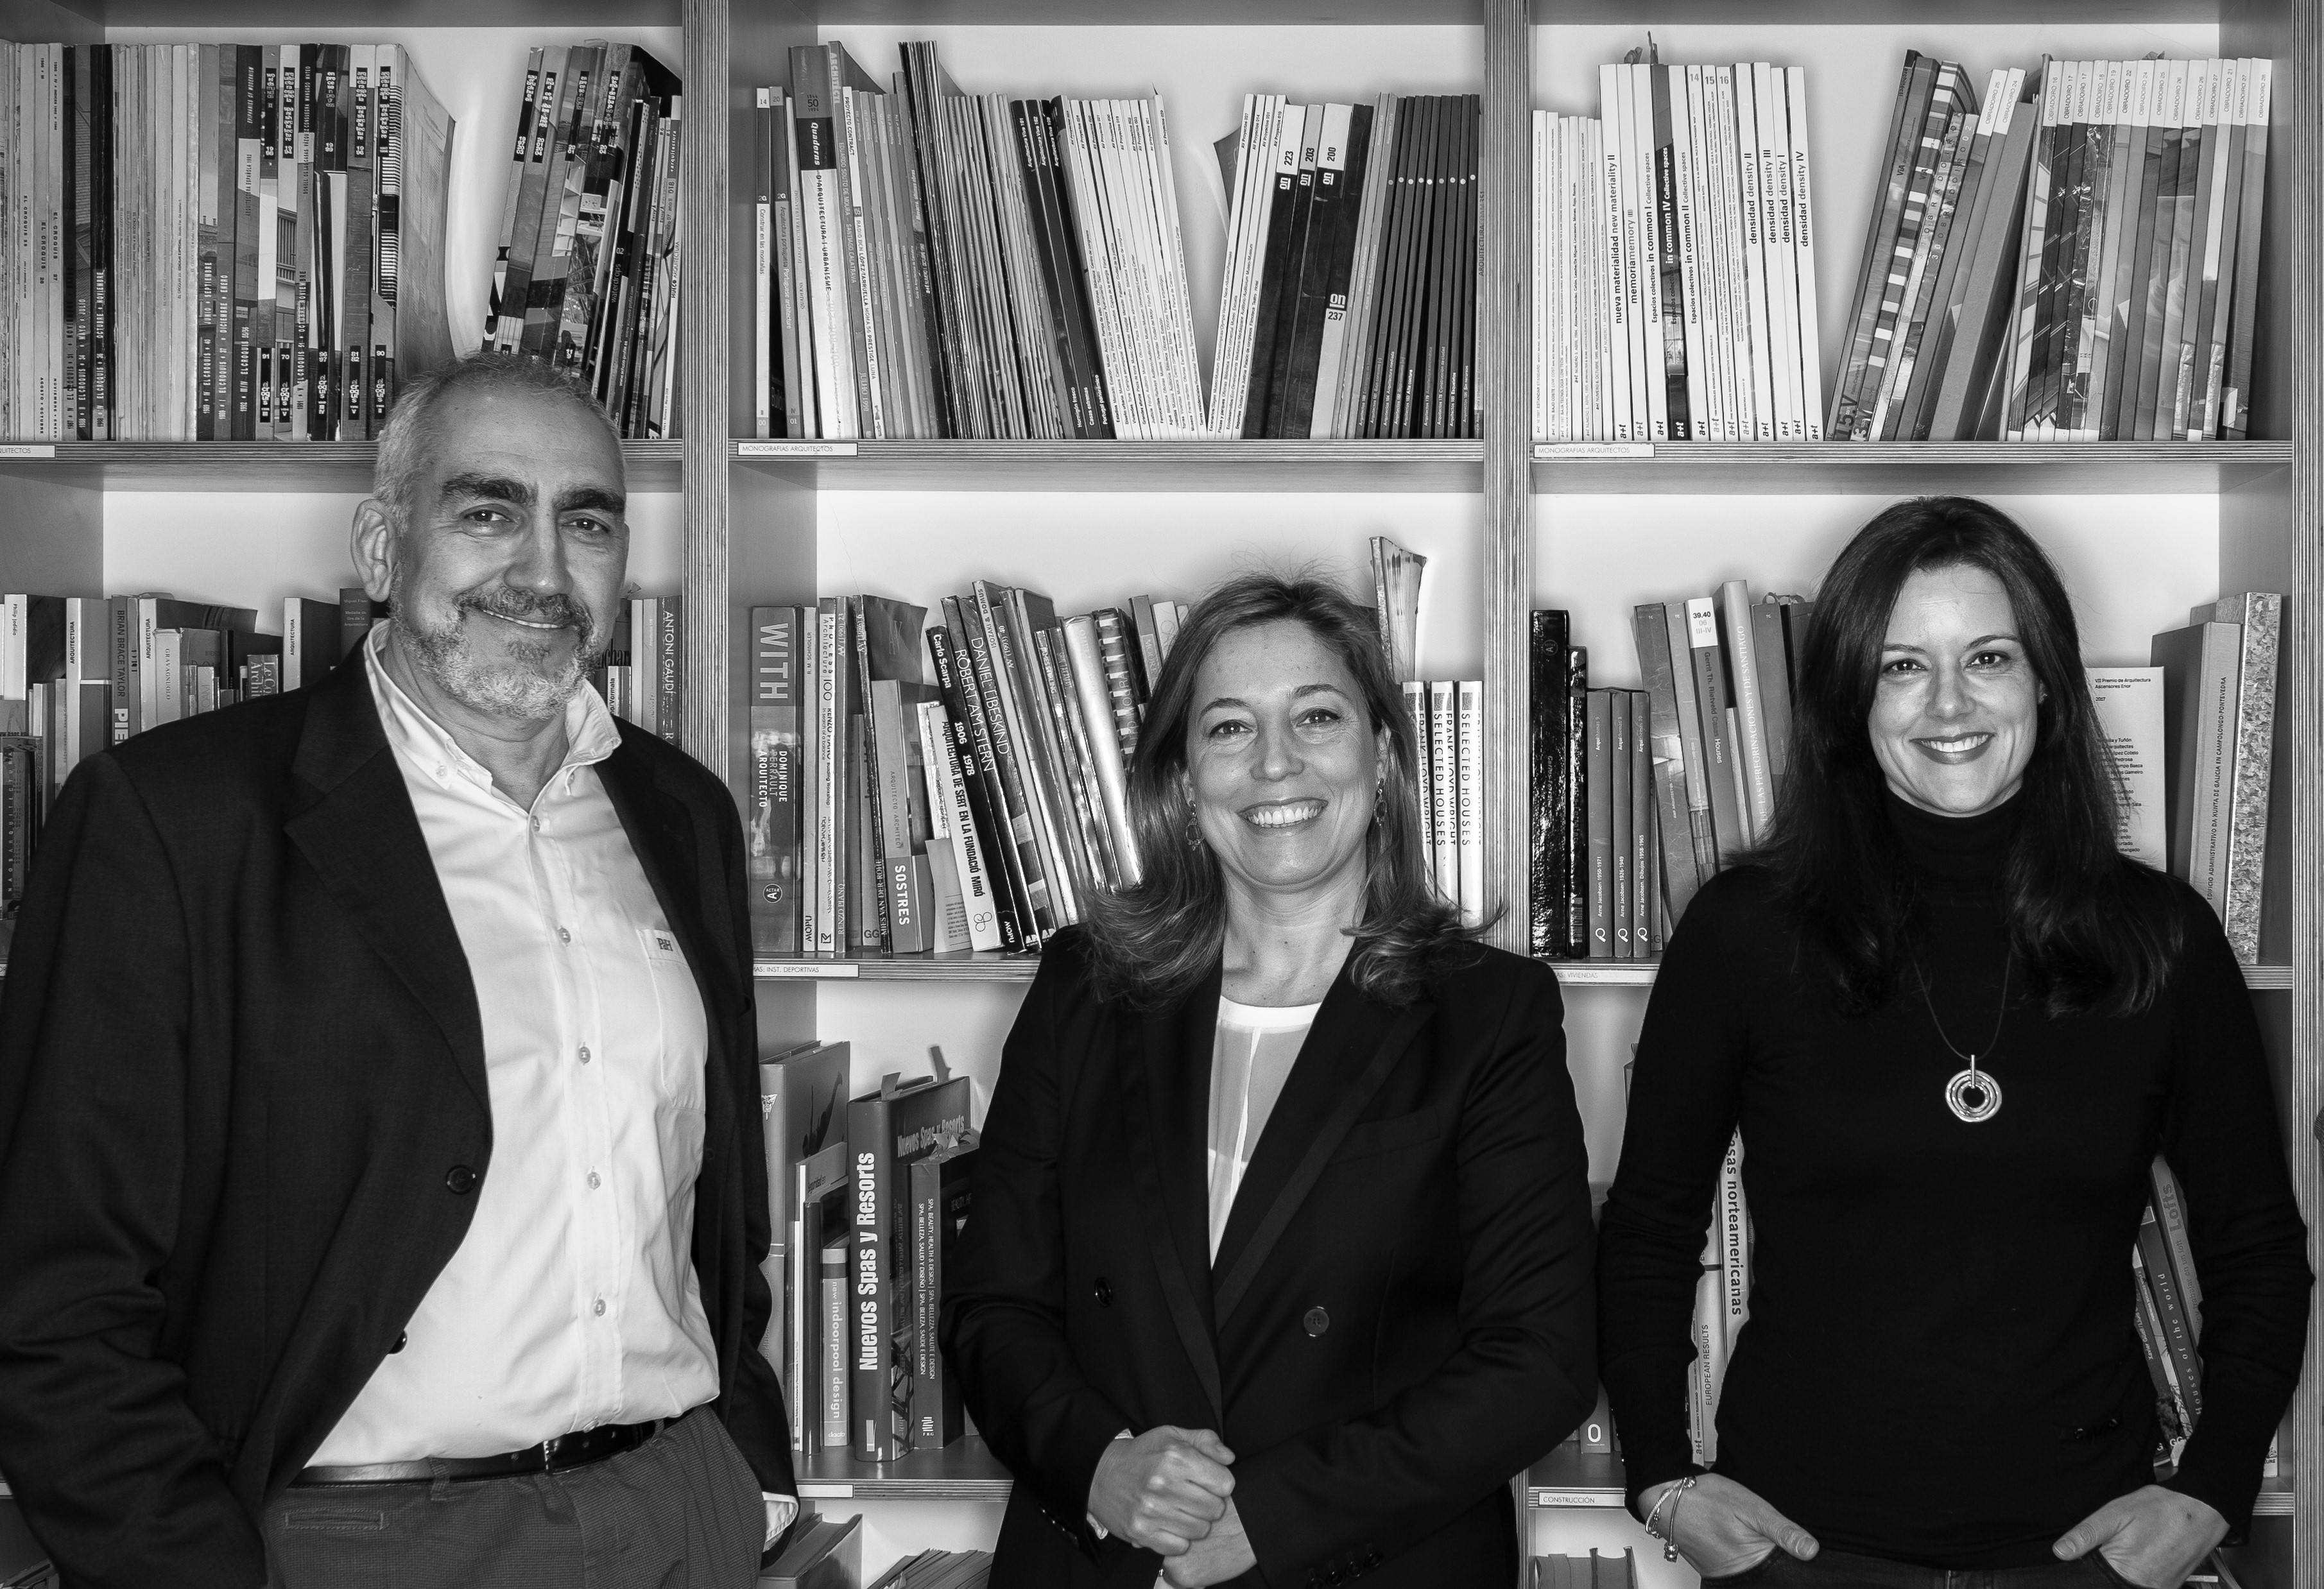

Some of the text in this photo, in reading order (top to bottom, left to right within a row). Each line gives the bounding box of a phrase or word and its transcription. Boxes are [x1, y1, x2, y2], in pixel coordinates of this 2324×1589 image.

[1284, 151, 1293, 166] 223
[1305, 148, 1314, 162] 203
[1327, 147, 1336, 162] 200
[1279, 177, 1291, 190] on
[1300, 173, 1311, 186] on
[1323, 172, 1334, 185] on
[1608, 163, 1618, 212] materiality
[1745, 162, 1756, 197] density
[1764, 161, 1775, 196] density
[1778, 160, 1789, 196] density
[811, 122, 821, 165] Quaderns
[816, 175, 827, 239] D'ARQUITECTURA
[822, 248, 831, 291] URBANISME
[1796, 151, 1808, 246] densidad density IV
[42, 222, 46, 230] EL
[1610, 214, 1618, 233] new
[1683, 214, 1692, 252] common
[1747, 200, 1757, 244] densidad
[1767, 200, 1777, 243] densidad
[1781, 200, 1790, 243] densidad
[1611, 236, 1621, 294] materialidad
[1685, 255, 1692, 263] in
[610, 264, 622, 303] waterdrops
[859, 253, 869, 306] LÓPEZ-TARRUELLA
[1328, 311, 1343, 321] 237
[1330, 293, 1346, 309] on
[1614, 296, 1622, 323] nueva
[859, 372, 868, 395] JULHO
[1094, 375, 1108, 424] Portugal panorámico
[1073, 404, 1082, 427] Hormigón
[664, 611, 674, 655] ANTONI
[1696, 626, 1712, 635] III-IV
[117, 610, 126, 697] BRIAN BRACE TAYLOR
[760, 623, 788, 700] WITH
[1737, 626, 1750, 674] SANTIAGO
[970, 637, 1010, 754] DANIEL LIBESKIND
[1707, 686, 1717, 714] Rietveld
[1743, 676, 1750, 689] DE
[954, 649, 995, 772] ROBERT AM STERN
[1712, 716, 1721, 737] Casas
[1714, 739, 1723, 763] Houses
[1745, 700, 1764, 786] PEREGRINACIONES
[759, 751, 768, 807] ARQUITECTO
[779, 752, 788, 802] DOMINIQUE
[933, 633, 1015, 943] Carlo Scarpa 1906 1978 MOPU
[952, 778, 963, 789] DE
[1434, 713, 1445, 846] SELECTED HOUSES
[1461, 713, 1470, 846] SELECTED HOUSES
[1756, 787, 1765, 804] LAS
[954, 790, 966, 809] SERT
[958, 812, 968, 821] EN
[961, 824, 971, 834] LA
[963, 836, 981, 873] FUNDACIÓ
[2208, 829, 2217, 875] ADMINISTRATIVO
[895, 865, 910, 925] SOSTRES
[970, 876, 985, 897] MIRÓ
[2161, 1184, 2182, 1232] Lofts
[857, 1153, 879, 1370] Nuevos Spas y Resorts
[1726, 1181, 1744, 1316] norteamericanas
[2156, 1273, 2174, 1311] world
[828, 1301, 842, 1371] indoorpool
[1701, 1325, 1713, 1406] EUROPEAN RESULTS
[829, 1377, 842, 1419] design
